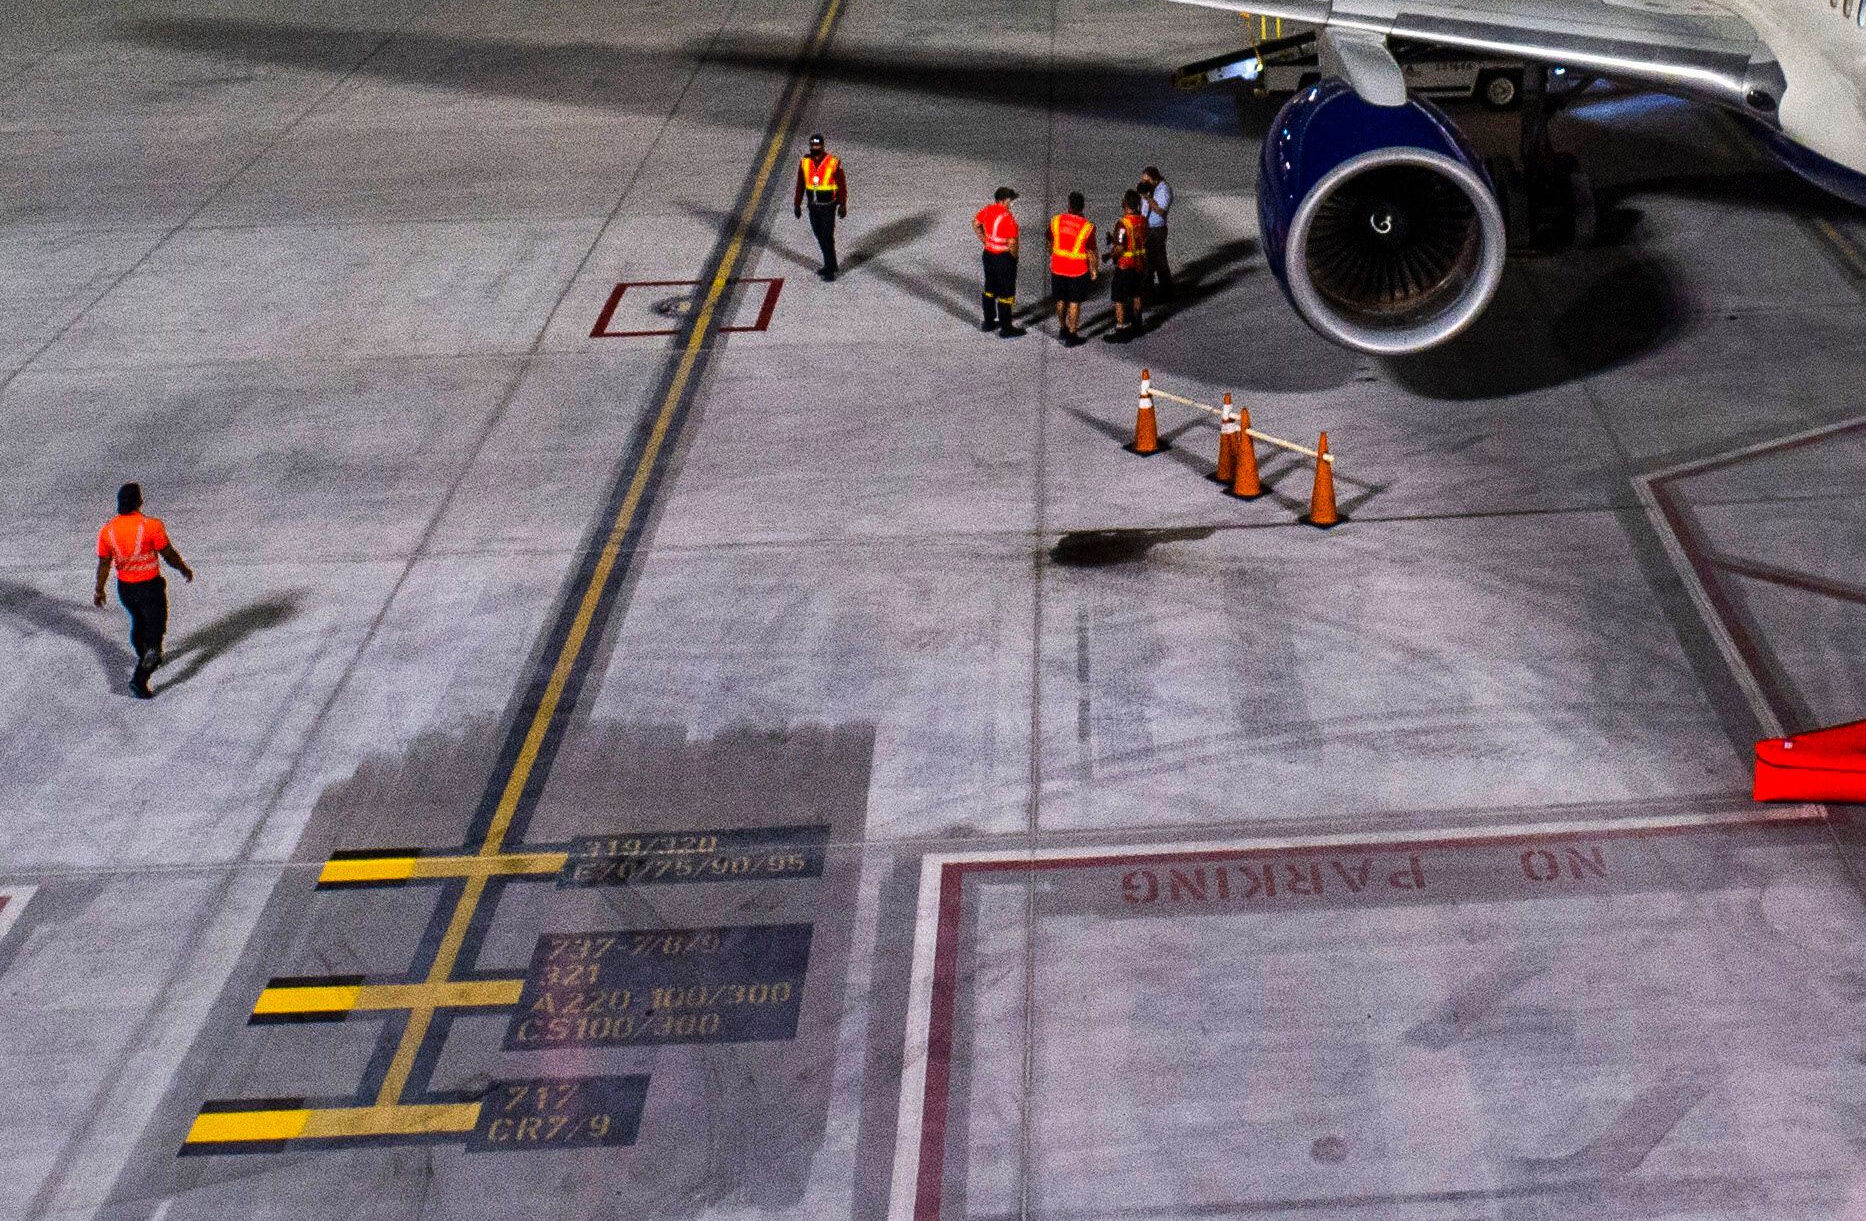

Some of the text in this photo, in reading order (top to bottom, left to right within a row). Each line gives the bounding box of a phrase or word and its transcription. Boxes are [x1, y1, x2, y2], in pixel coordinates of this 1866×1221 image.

[1122, 846, 1609, 905] NO PARKING
[505, 1082, 581, 1111] 717
[487, 1114, 612, 1144] CR7/9
